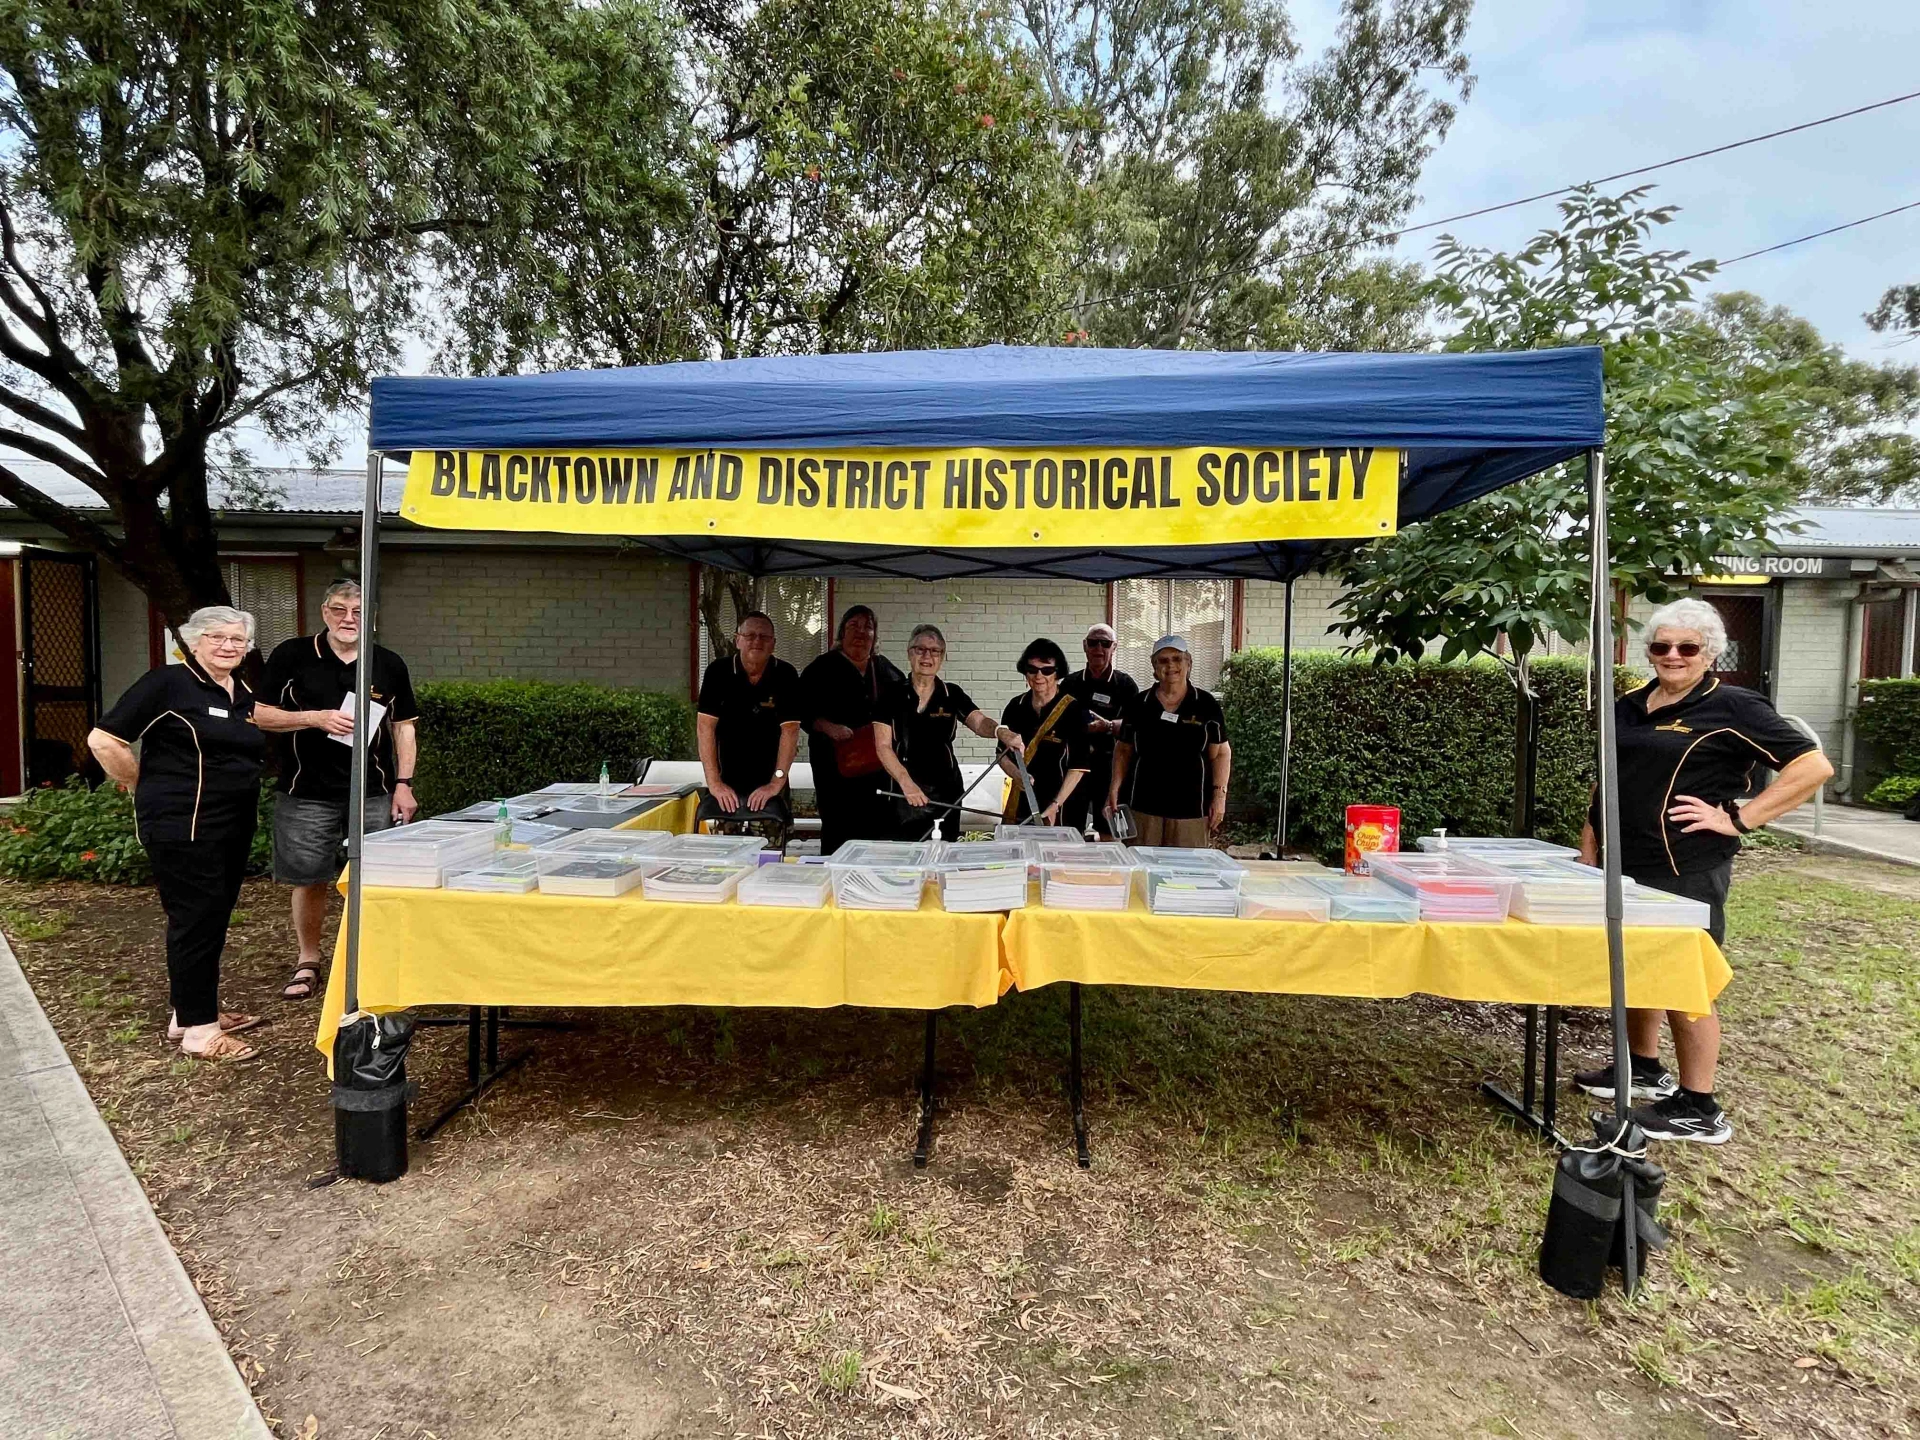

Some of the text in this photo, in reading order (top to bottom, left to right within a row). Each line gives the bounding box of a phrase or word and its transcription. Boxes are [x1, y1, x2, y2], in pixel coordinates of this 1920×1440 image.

[431, 447, 1374, 511] BLACKTOWN AND DISTRICT HISTORICAL SOCIETY
[1765, 557, 1823, 574] ROOM
[1357, 831, 1380, 840] Chupa
[1356, 839, 1379, 848] Chups
